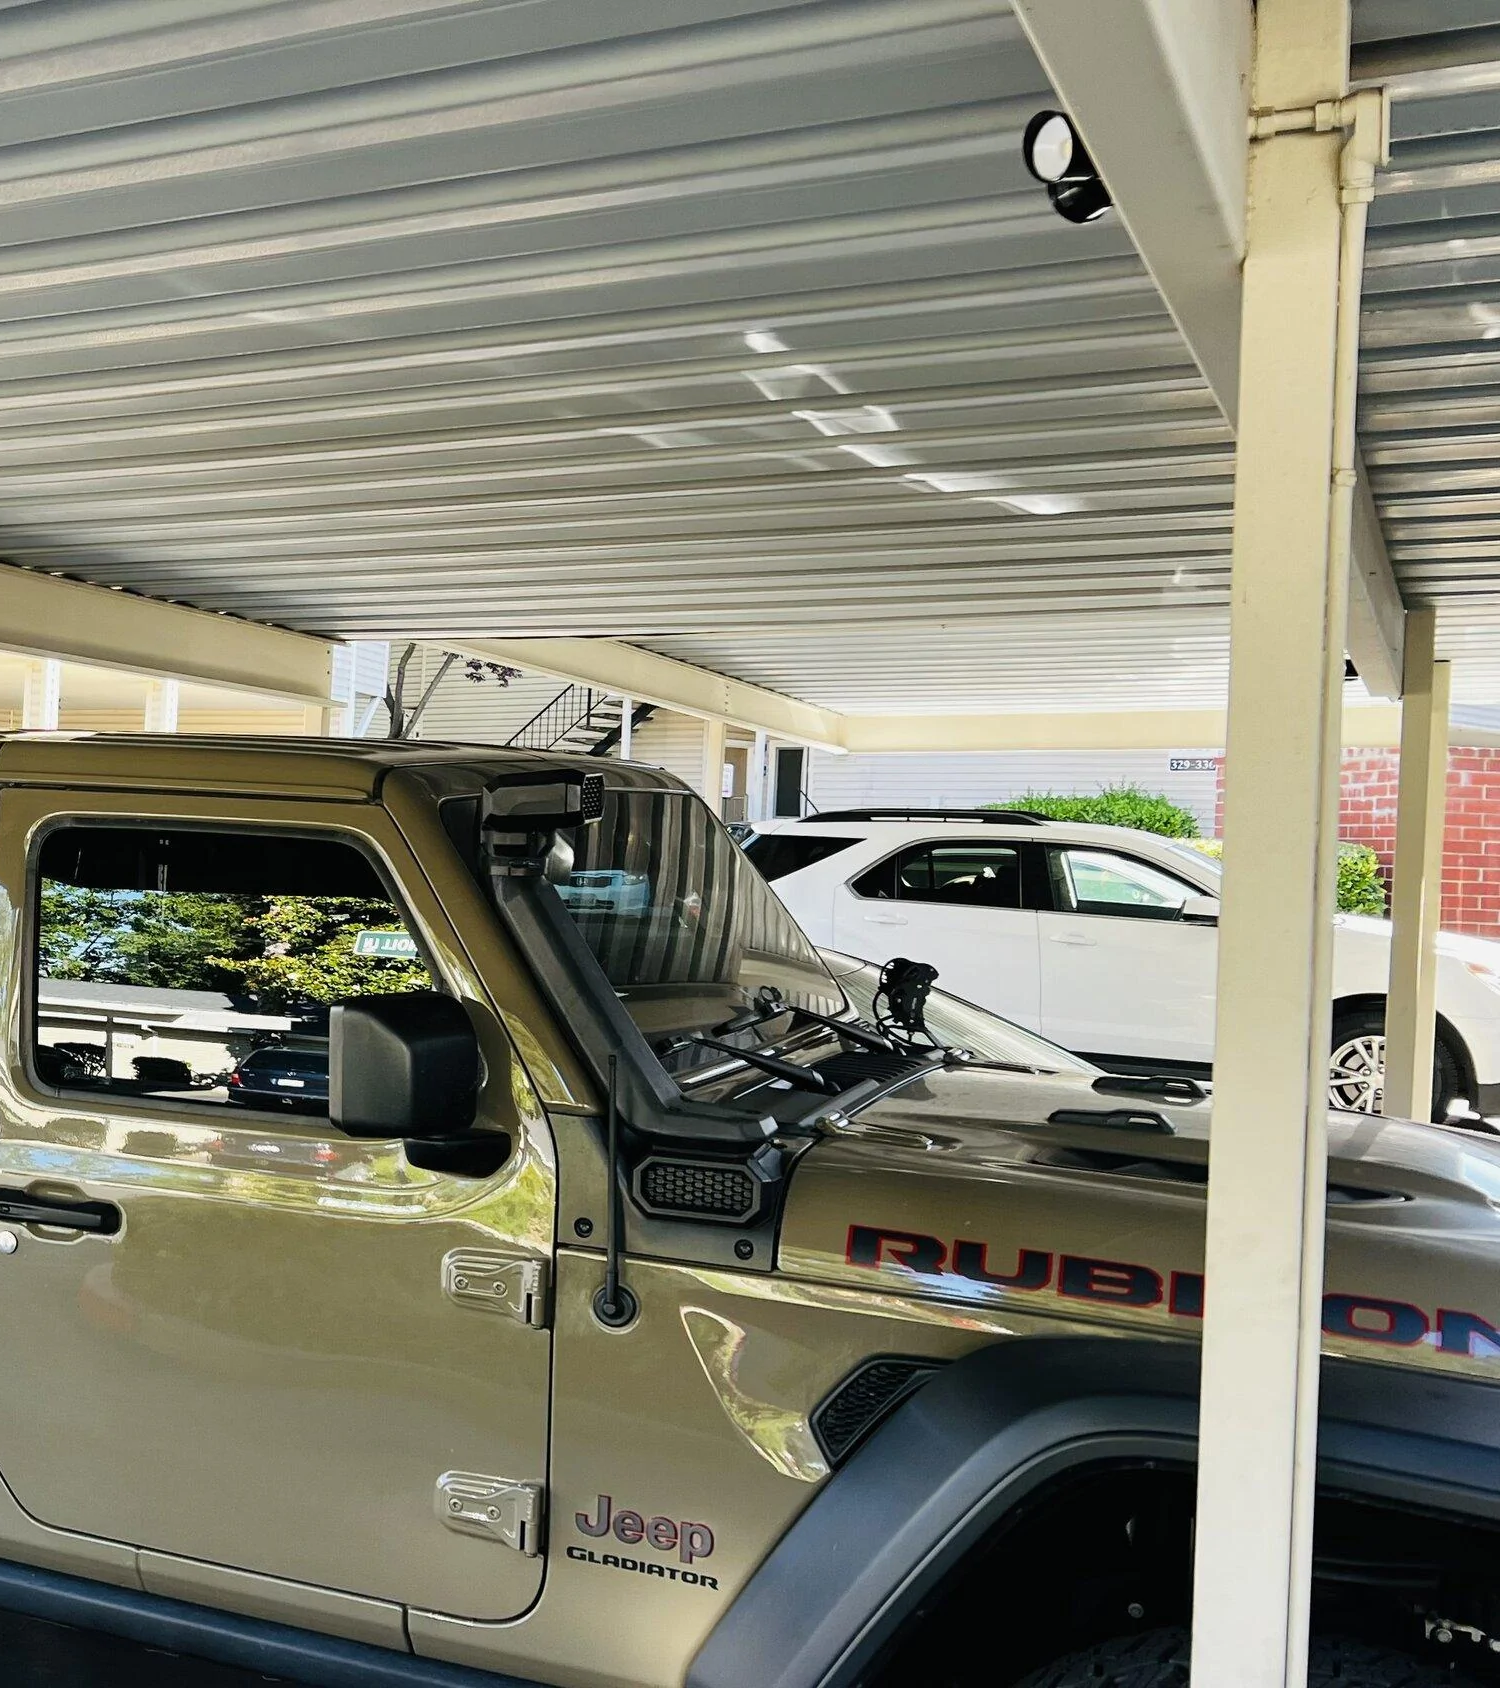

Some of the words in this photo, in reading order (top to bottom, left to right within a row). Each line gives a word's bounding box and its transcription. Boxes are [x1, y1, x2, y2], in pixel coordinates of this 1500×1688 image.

[845, 1224, 1500, 1357] RUBION
[575, 1494, 714, 1564] Jeep
[566, 1546, 719, 1590] GLADIATOR
